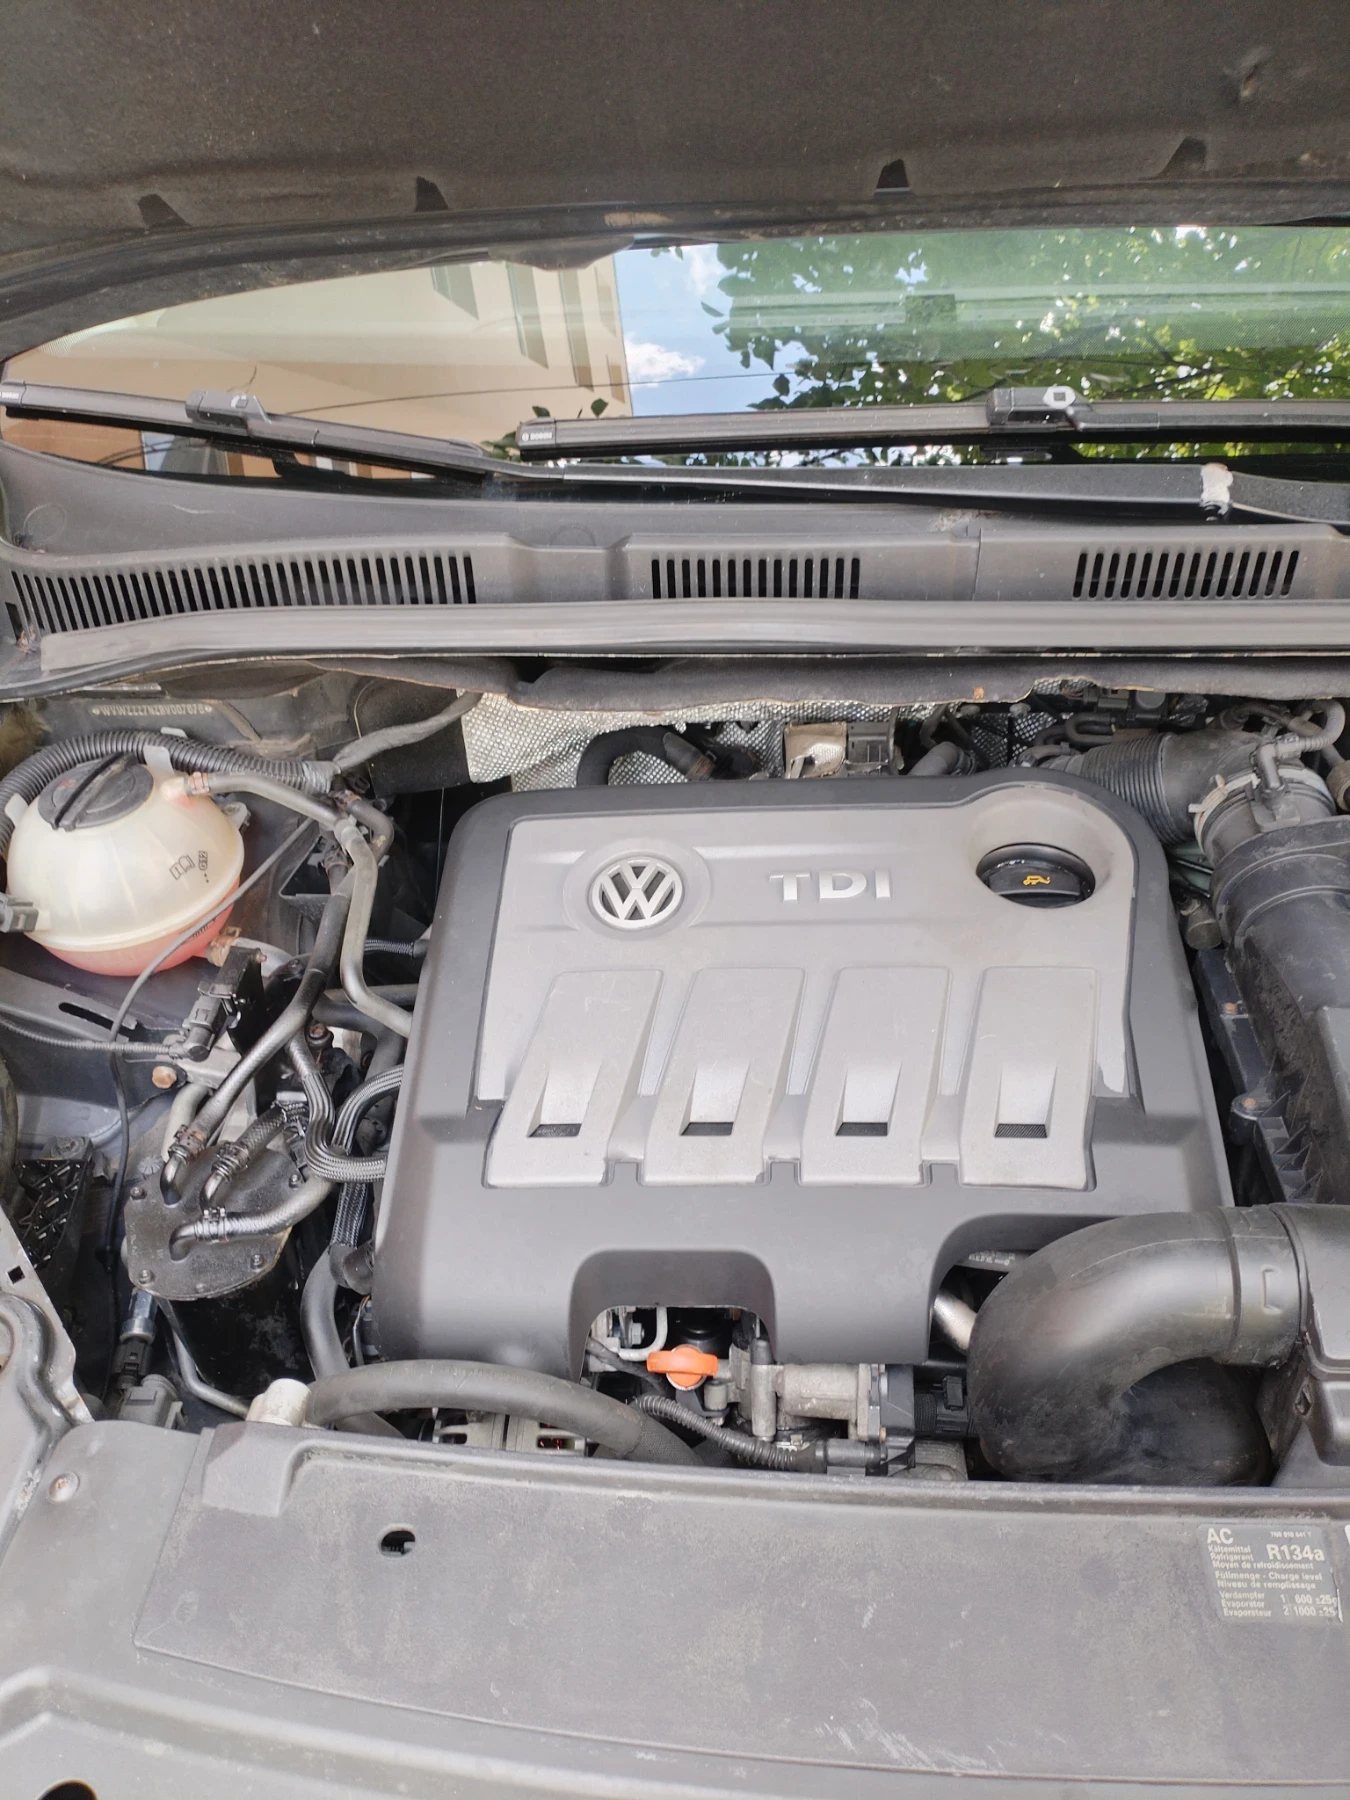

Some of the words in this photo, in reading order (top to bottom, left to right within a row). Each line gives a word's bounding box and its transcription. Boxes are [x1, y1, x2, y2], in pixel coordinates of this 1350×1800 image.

[769, 868, 892, 901] TDI
[1207, 1527, 1234, 1544] AC
[1210, 1552, 1254, 1562] Refrigerant
[1266, 1544, 1325, 1561] R134a
[1212, 1561, 1239, 1570] Moyen
[1242, 1561, 1252, 1569] de
[1253, 1561, 1314, 1570] refroidissement
[1215, 1571, 1260, 1581] Füllmenge
[1268, 1571, 1299, 1581] Charge
[1217, 1580, 1248, 1588] Niveau
[1250, 1580, 1260, 1588] de
[1264, 1580, 1316, 1590] remplissage
[1221, 1599, 1265, 1609] Evaporator
[1224, 1608, 1272, 1617] Evaporateur
[1283, 1607, 1289, 1616] 2
[1293, 1606, 1316, 1616] 1000
[1319, 1606, 1337, 1617] ±25
